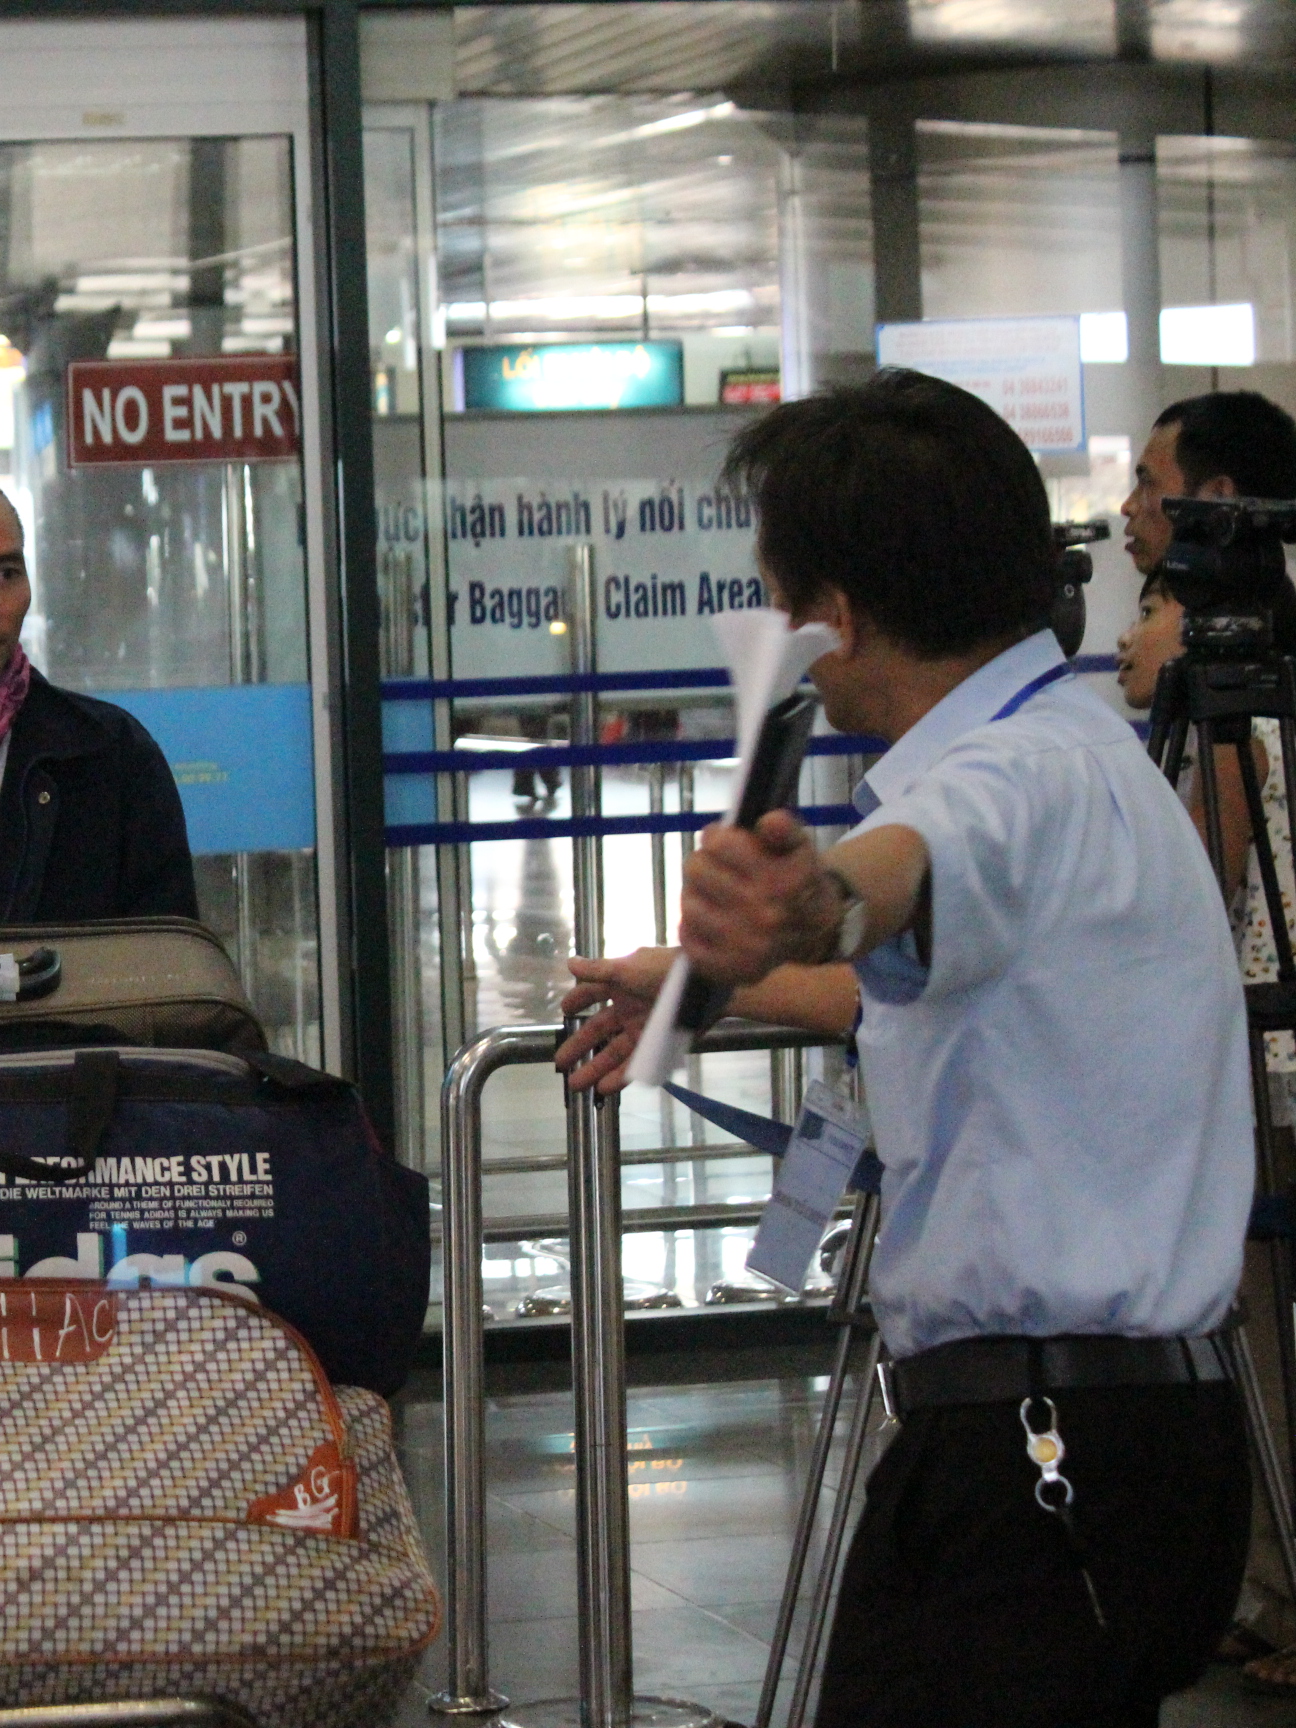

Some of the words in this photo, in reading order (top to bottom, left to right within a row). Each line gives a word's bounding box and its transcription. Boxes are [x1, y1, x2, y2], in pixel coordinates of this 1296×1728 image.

[81, 385, 150, 446] NO
[448, 492, 506, 548] hận
[516, 491, 592, 537] hành
[603, 488, 628, 540] lý
[469, 580, 560, 630] Bagga
[604, 573, 686, 620] Claim
[696, 571, 762, 616] Area
[190, 1152, 273, 1183] STYLE
[0, 1186, 22, 1200] DIE
[25, 1186, 110, 1200] WELTMARKE
[113, 1186, 138, 1198] MIT
[141, 1185, 171, 1197] DEN
[174, 1184, 206, 1197] DREI
[208, 1183, 273, 1196] STREIFEN
[89, 1201, 123, 1210] AROUND
[133, 1201, 160, 1209] THEME
[162, 1200, 174, 1208] OF
[89, 1211, 106, 1220] FOR
[110, 1211, 140, 1219] TENNIS
[144, 1210, 175, 1218] ADIDAS
[178, 1210, 187, 1218] IS
[190, 1209, 223, 1217] ALWAYS
[226, 1209, 259, 1217] MAKING
[261, 1208, 274, 1217] US
[89, 1221, 110, 1230] FEEL
[133, 1220, 161, 1228] WAVES
[163, 1220, 175, 1228] OF
[178, 1219, 195, 1228] THE
[197, 1219, 216, 1228] AGE
